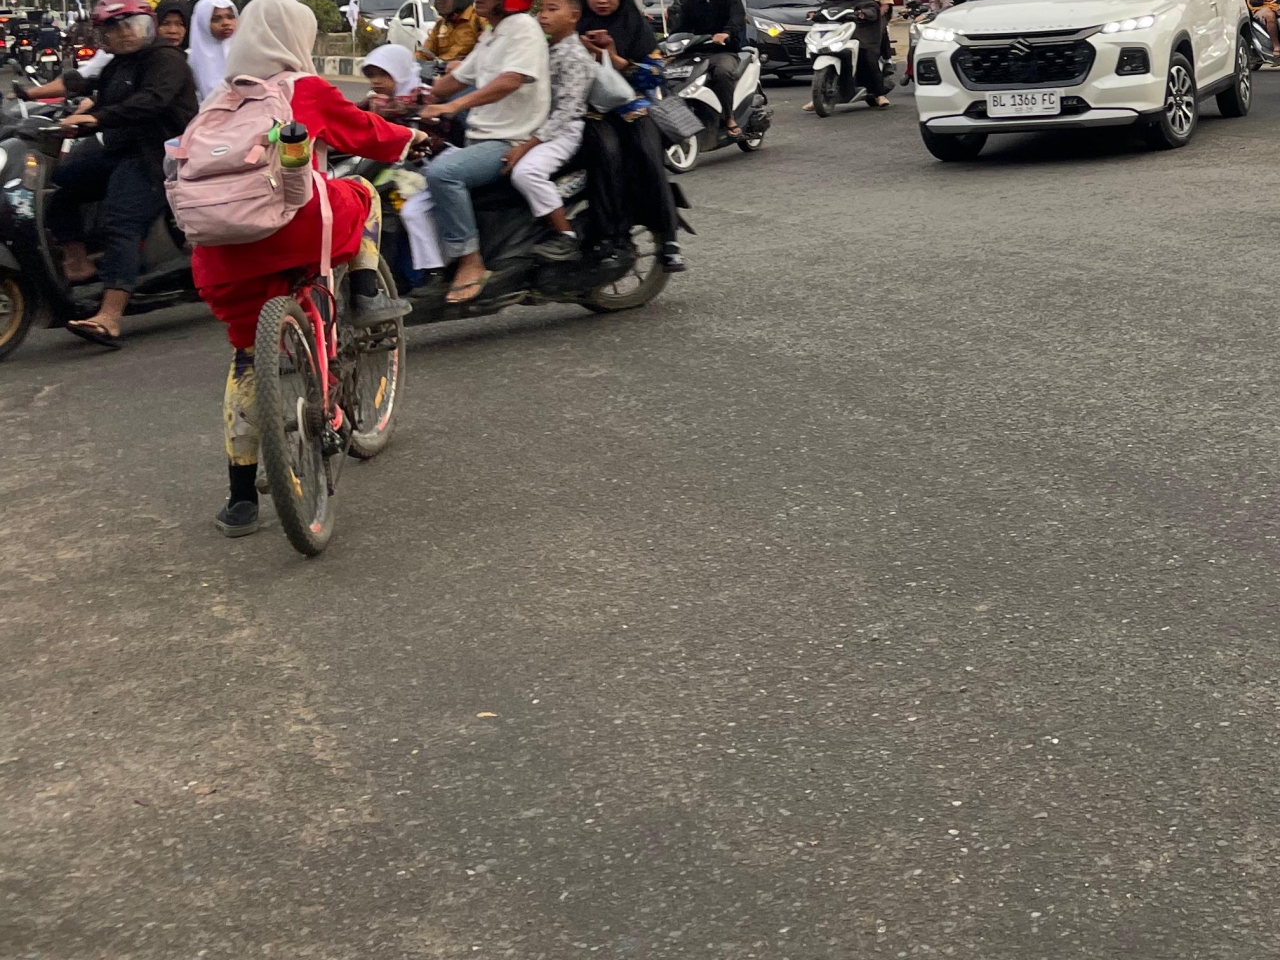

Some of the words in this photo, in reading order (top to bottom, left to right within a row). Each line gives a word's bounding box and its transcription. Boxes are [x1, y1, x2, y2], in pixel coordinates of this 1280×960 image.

[992, 95, 1006, 108] BL
[1010, 93, 1037, 106] 1366
[1041, 92, 1056, 106] FC
